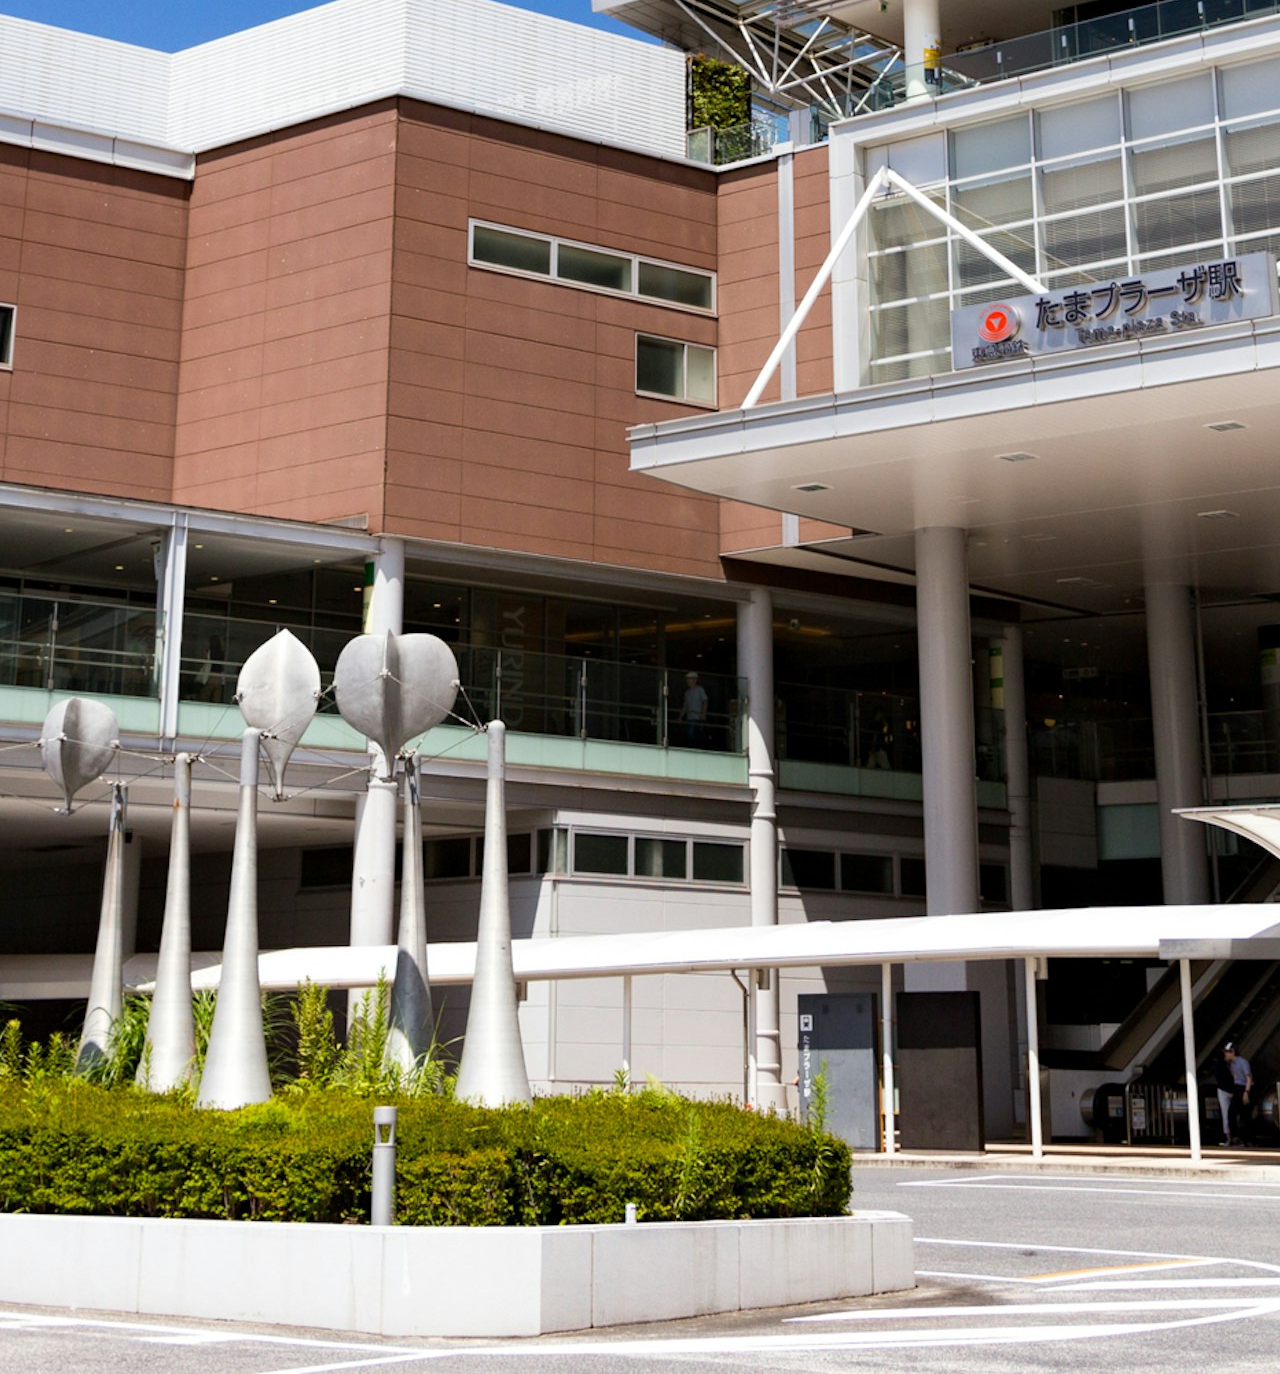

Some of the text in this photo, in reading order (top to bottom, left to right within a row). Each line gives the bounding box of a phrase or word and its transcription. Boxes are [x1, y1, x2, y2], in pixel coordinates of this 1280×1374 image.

[1035, 261, 1240, 329] たまプラーザ駅
[803, 1035, 811, 1098] たまプラーザ駅
